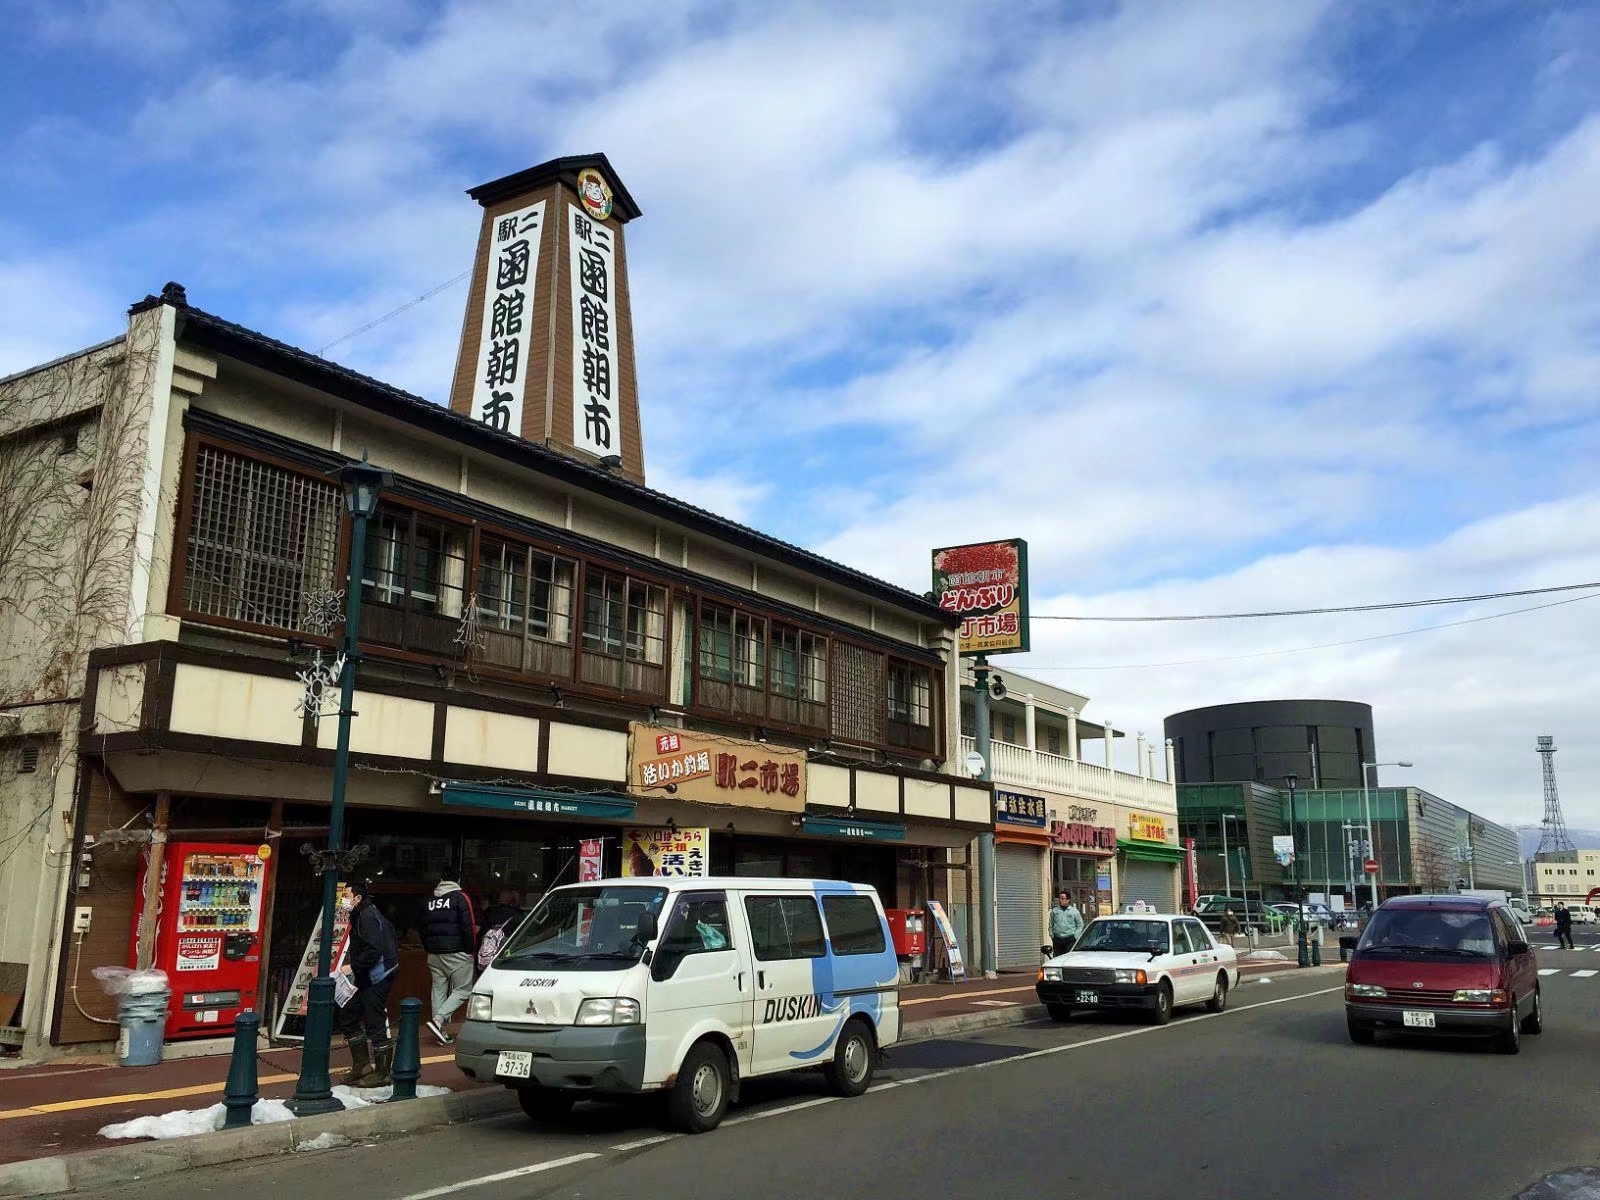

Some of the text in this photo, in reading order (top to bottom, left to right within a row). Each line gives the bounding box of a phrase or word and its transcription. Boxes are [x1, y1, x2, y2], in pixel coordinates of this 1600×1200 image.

[940, 584, 1014, 612] どんぶり
[960, 612, 1019, 638] 丁市場
[660, 735, 679, 751] 元祖
[643, 751, 711, 787] 活いか釣堀
[715, 752, 800, 798] 駅二市場
[643, 831, 702, 842] 入口はこちら
[660, 842, 688, 852] 元祖
[428, 898, 450, 911] USA
